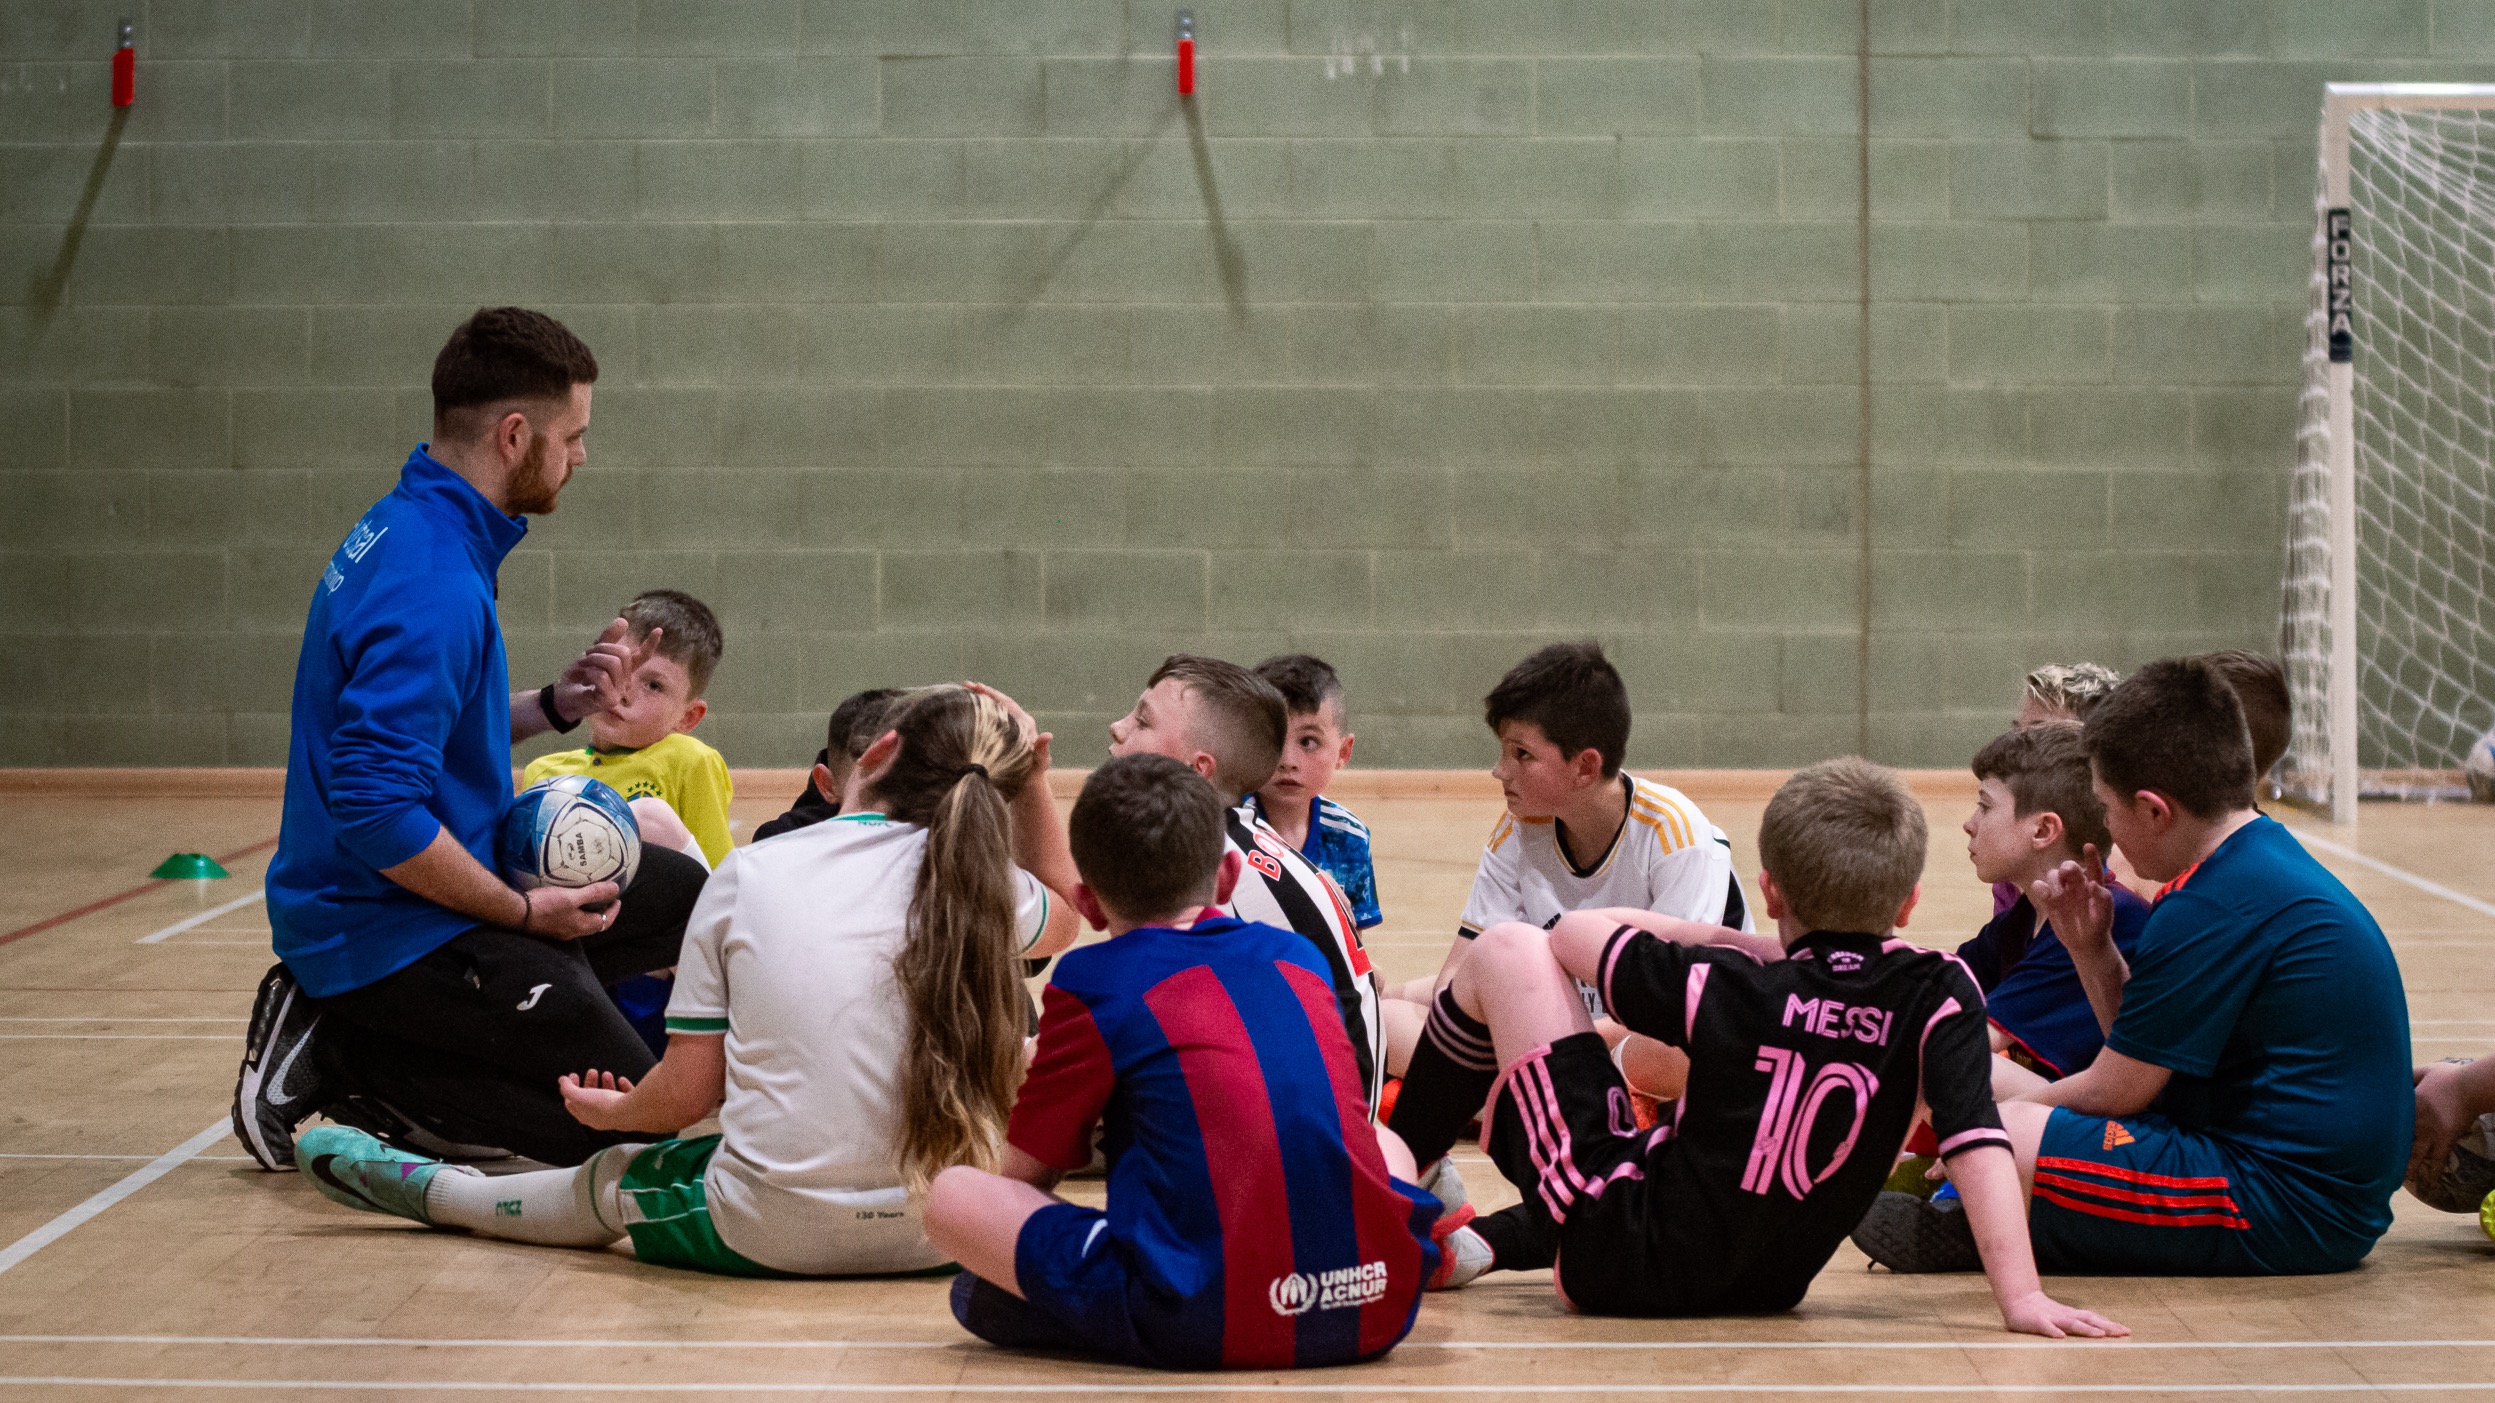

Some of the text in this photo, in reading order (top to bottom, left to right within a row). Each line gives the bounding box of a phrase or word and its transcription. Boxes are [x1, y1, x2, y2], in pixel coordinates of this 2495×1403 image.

[2330, 215, 2351, 334] FORZA
[575, 832, 587, 867] SAMBA
[1782, 992, 1894, 1046] MESSI
[1739, 1044, 1880, 1201] 10
[1320, 1261, 1387, 1287] UNHCR
[1320, 1278, 1387, 1302] ACNUR
